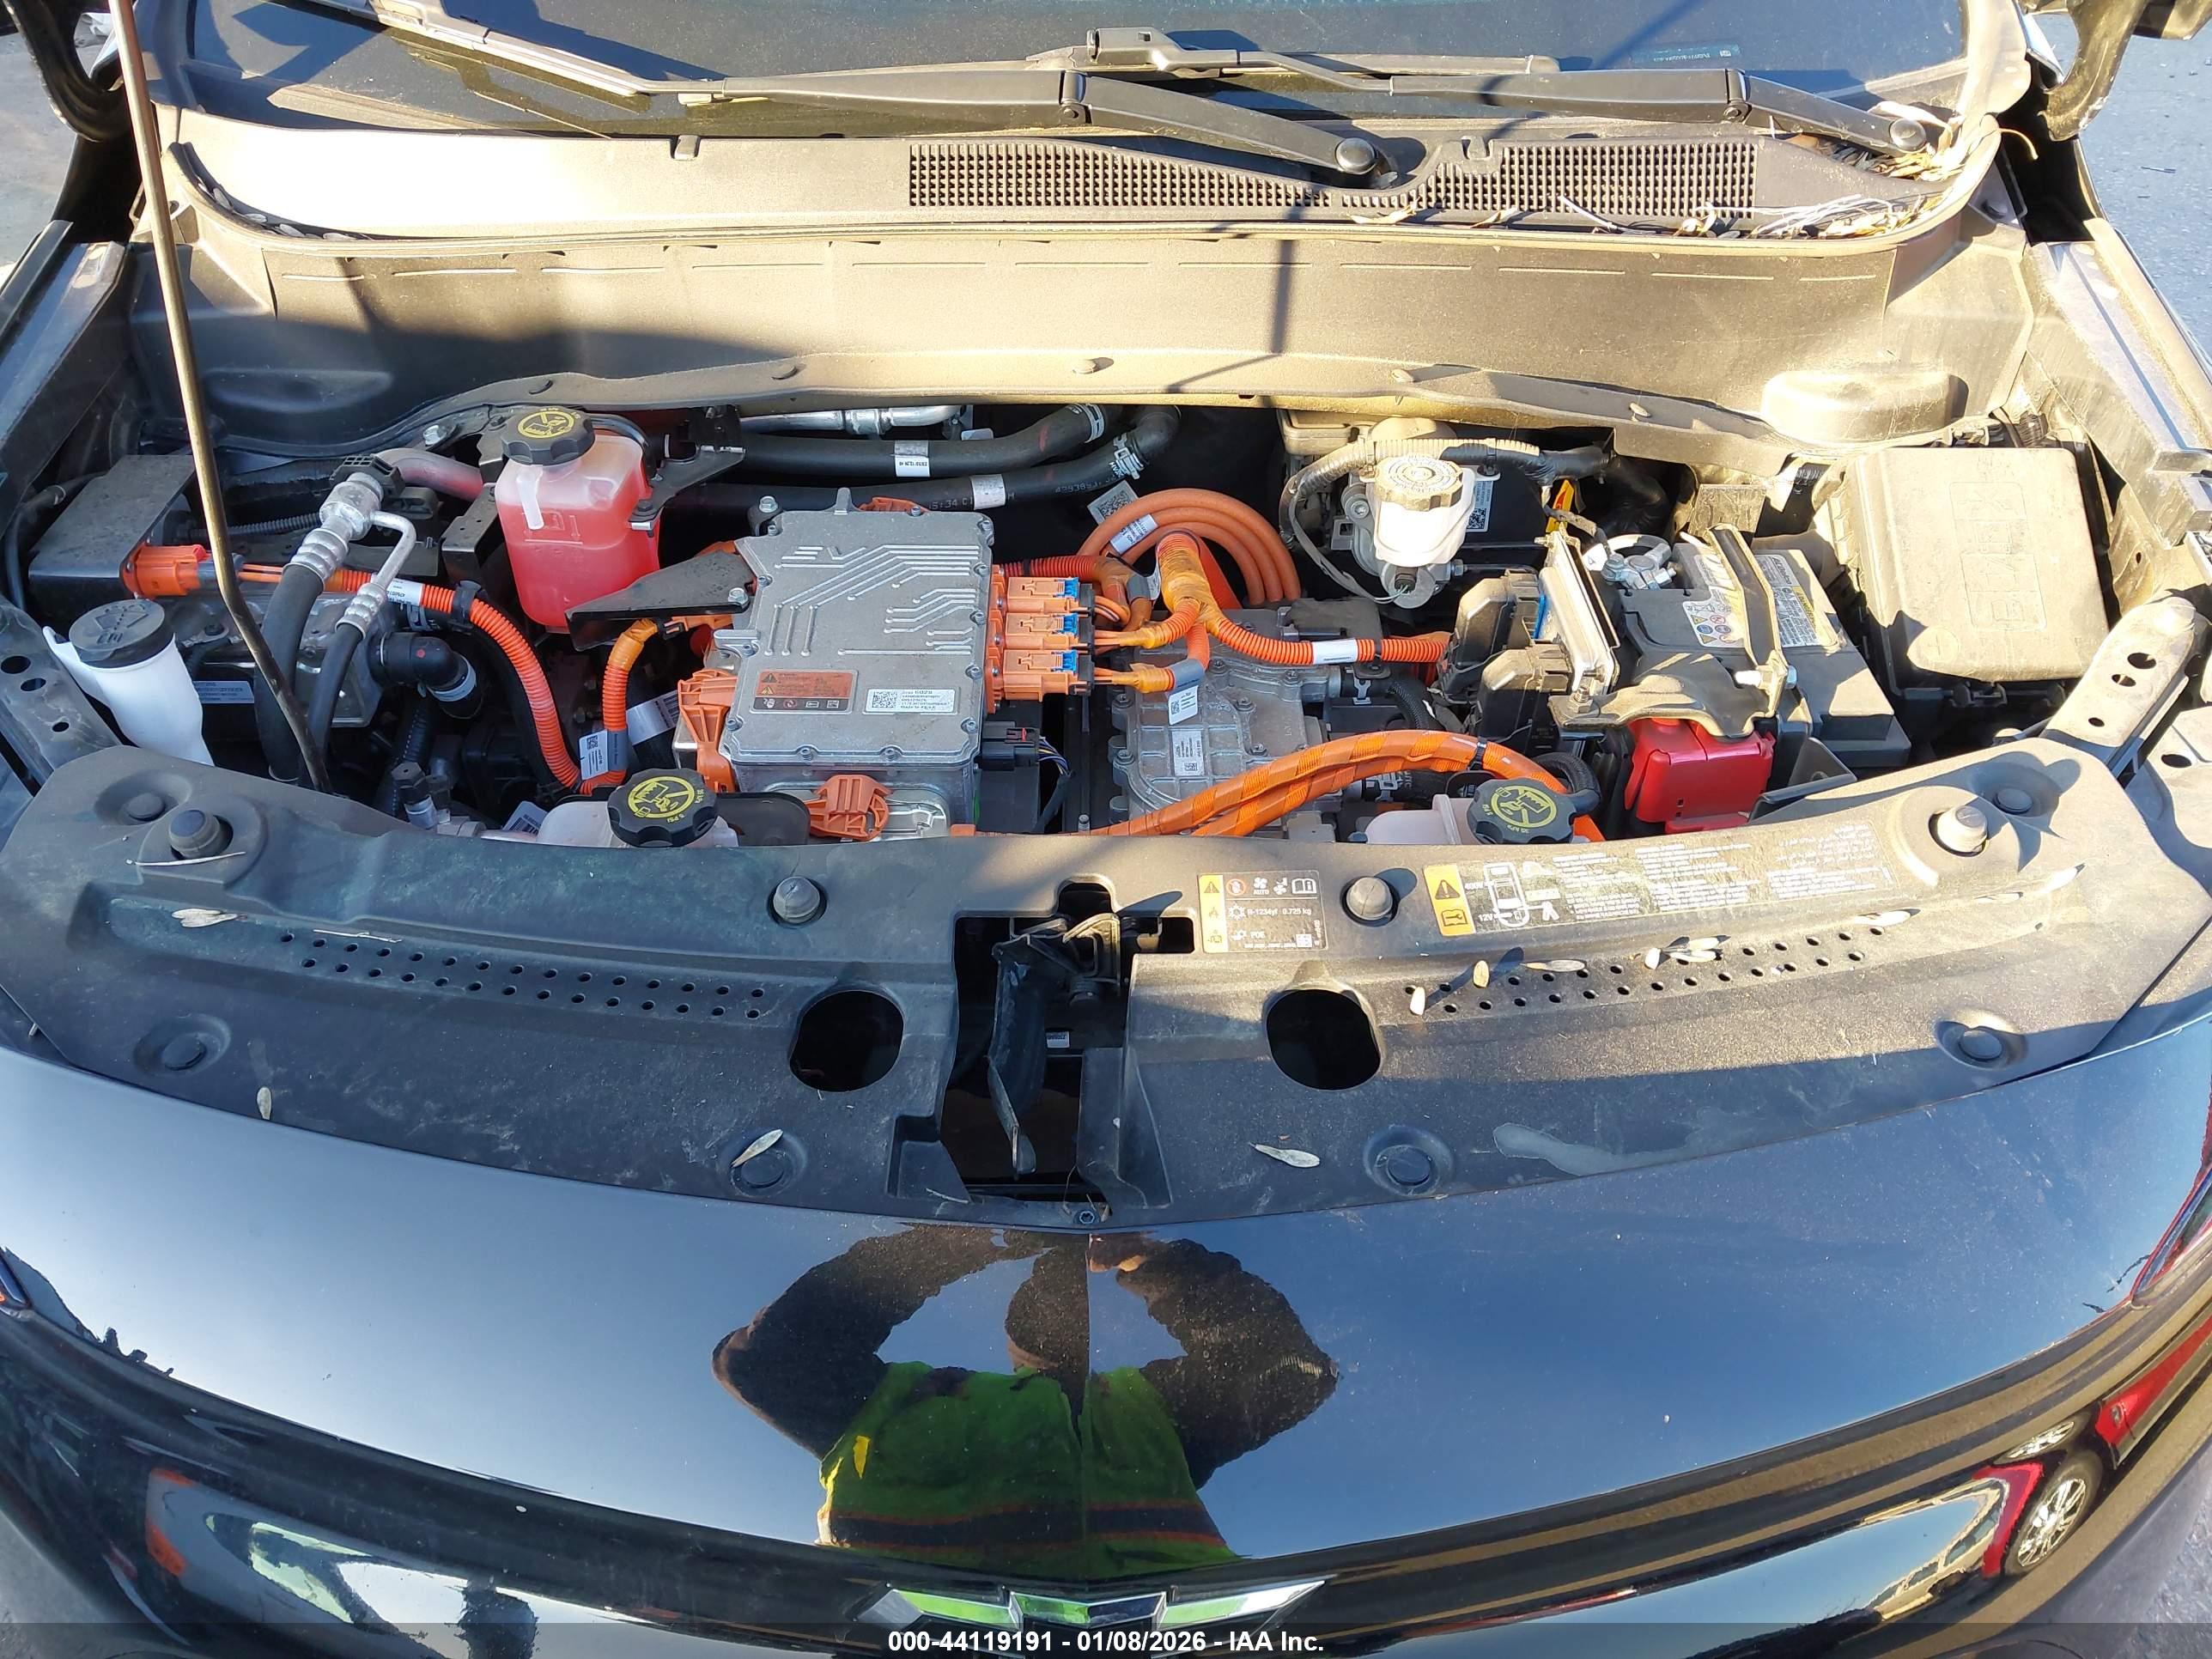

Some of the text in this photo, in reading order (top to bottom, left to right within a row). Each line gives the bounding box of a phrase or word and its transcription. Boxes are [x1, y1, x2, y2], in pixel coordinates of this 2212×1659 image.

[1771, 557, 1792, 585] ACDelco
[1247, 908, 1278, 917] R-1234yf
[1303, 908, 1312, 916] kg
